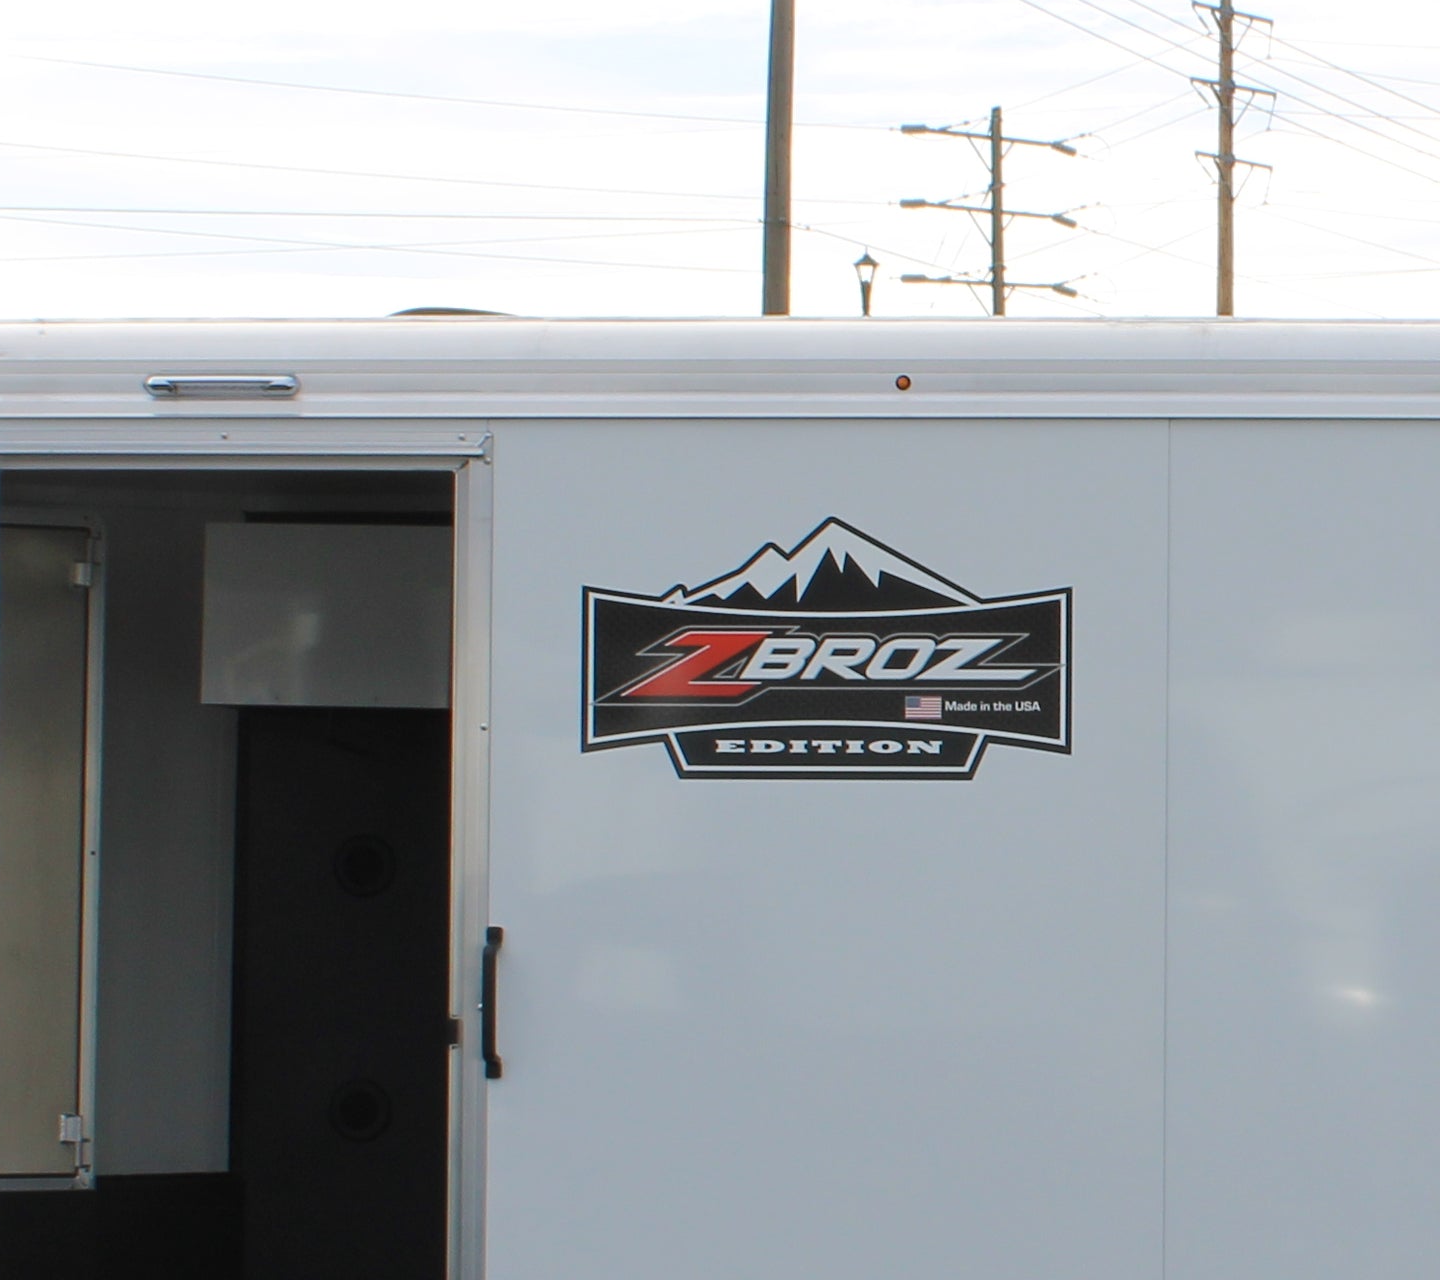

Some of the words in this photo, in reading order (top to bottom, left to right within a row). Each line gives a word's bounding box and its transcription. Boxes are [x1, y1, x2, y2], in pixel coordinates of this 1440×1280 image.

[621, 630, 1038, 698] ZBROZ
[944, 700, 978, 712] Made
[980, 700, 991, 712] in
[993, 700, 1013, 712] the
[1015, 700, 1042, 712] USA
[715, 738, 944, 756] EDITION
